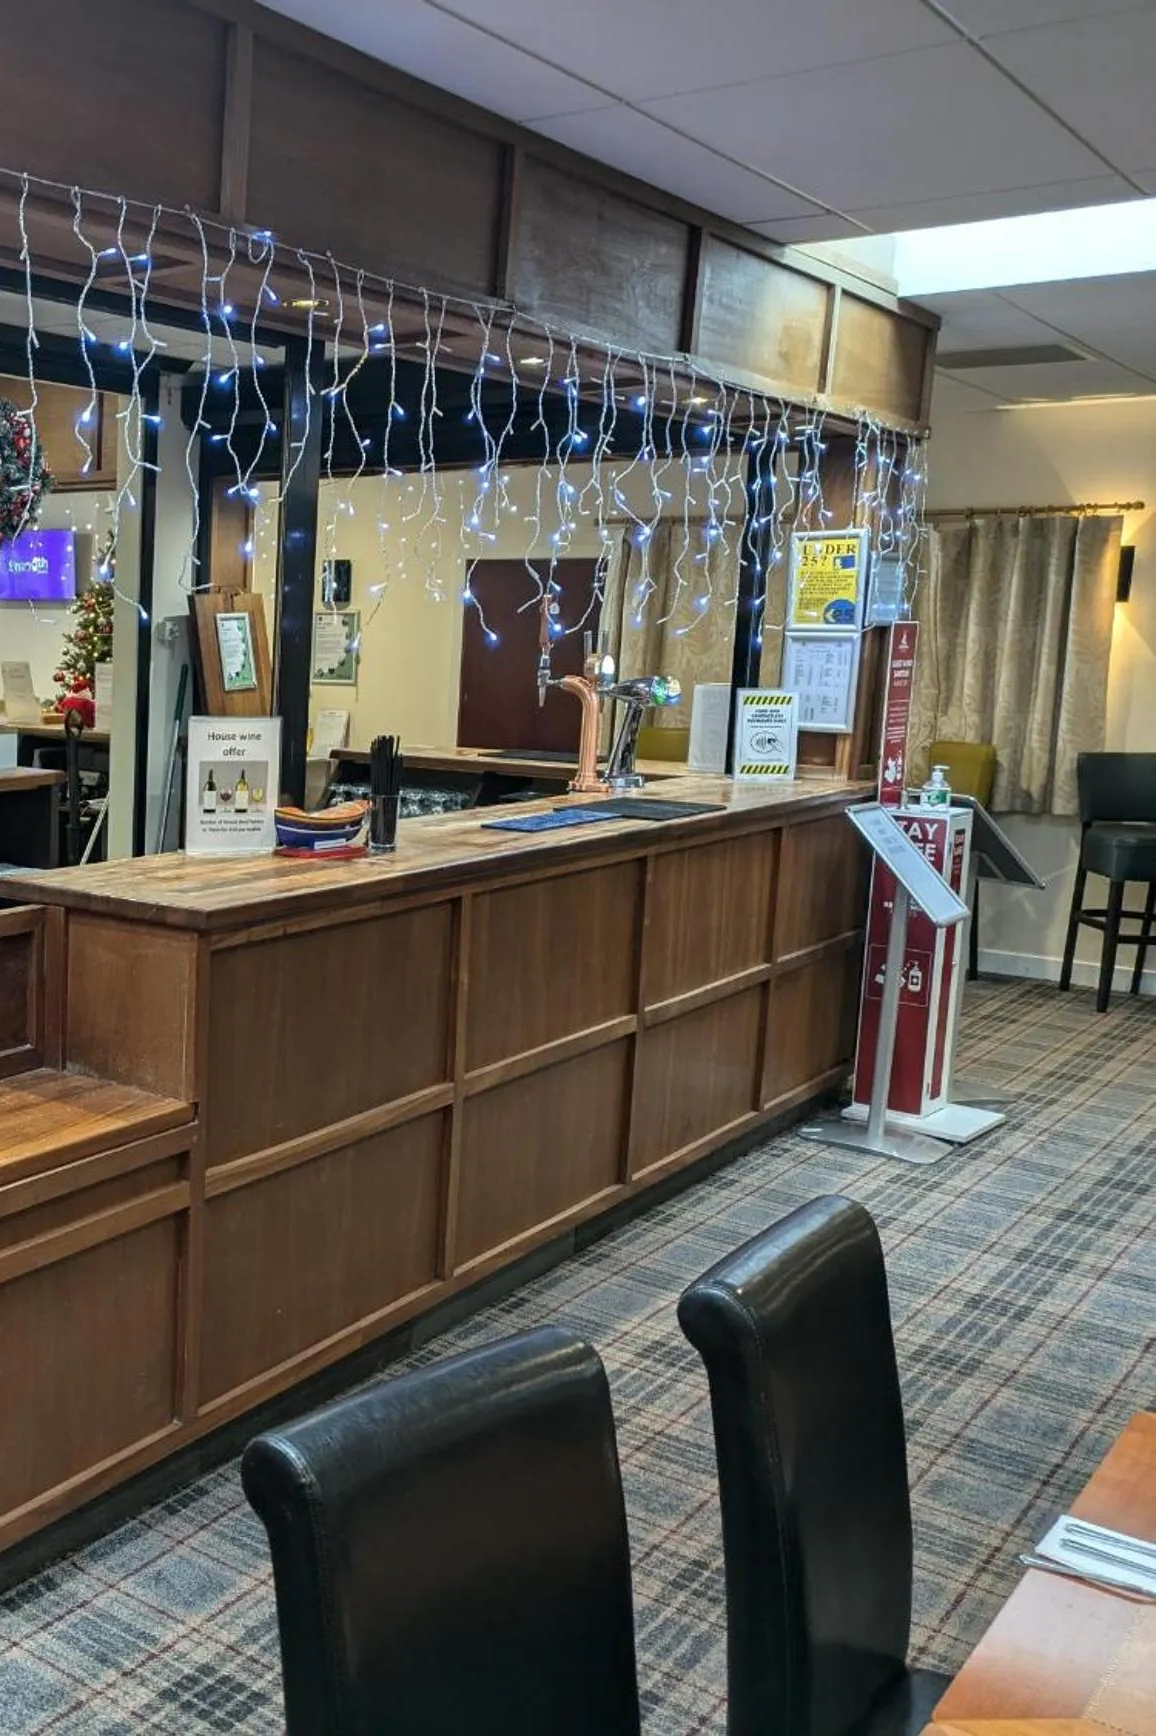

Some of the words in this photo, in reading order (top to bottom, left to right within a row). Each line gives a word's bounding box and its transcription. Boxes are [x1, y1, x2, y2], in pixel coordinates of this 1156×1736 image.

[803, 544, 856, 554] UDER
[207, 732, 237, 741] House
[240, 732, 262, 741] wine
[222, 747, 246, 757] offer
[899, 820, 939, 840] TAY
